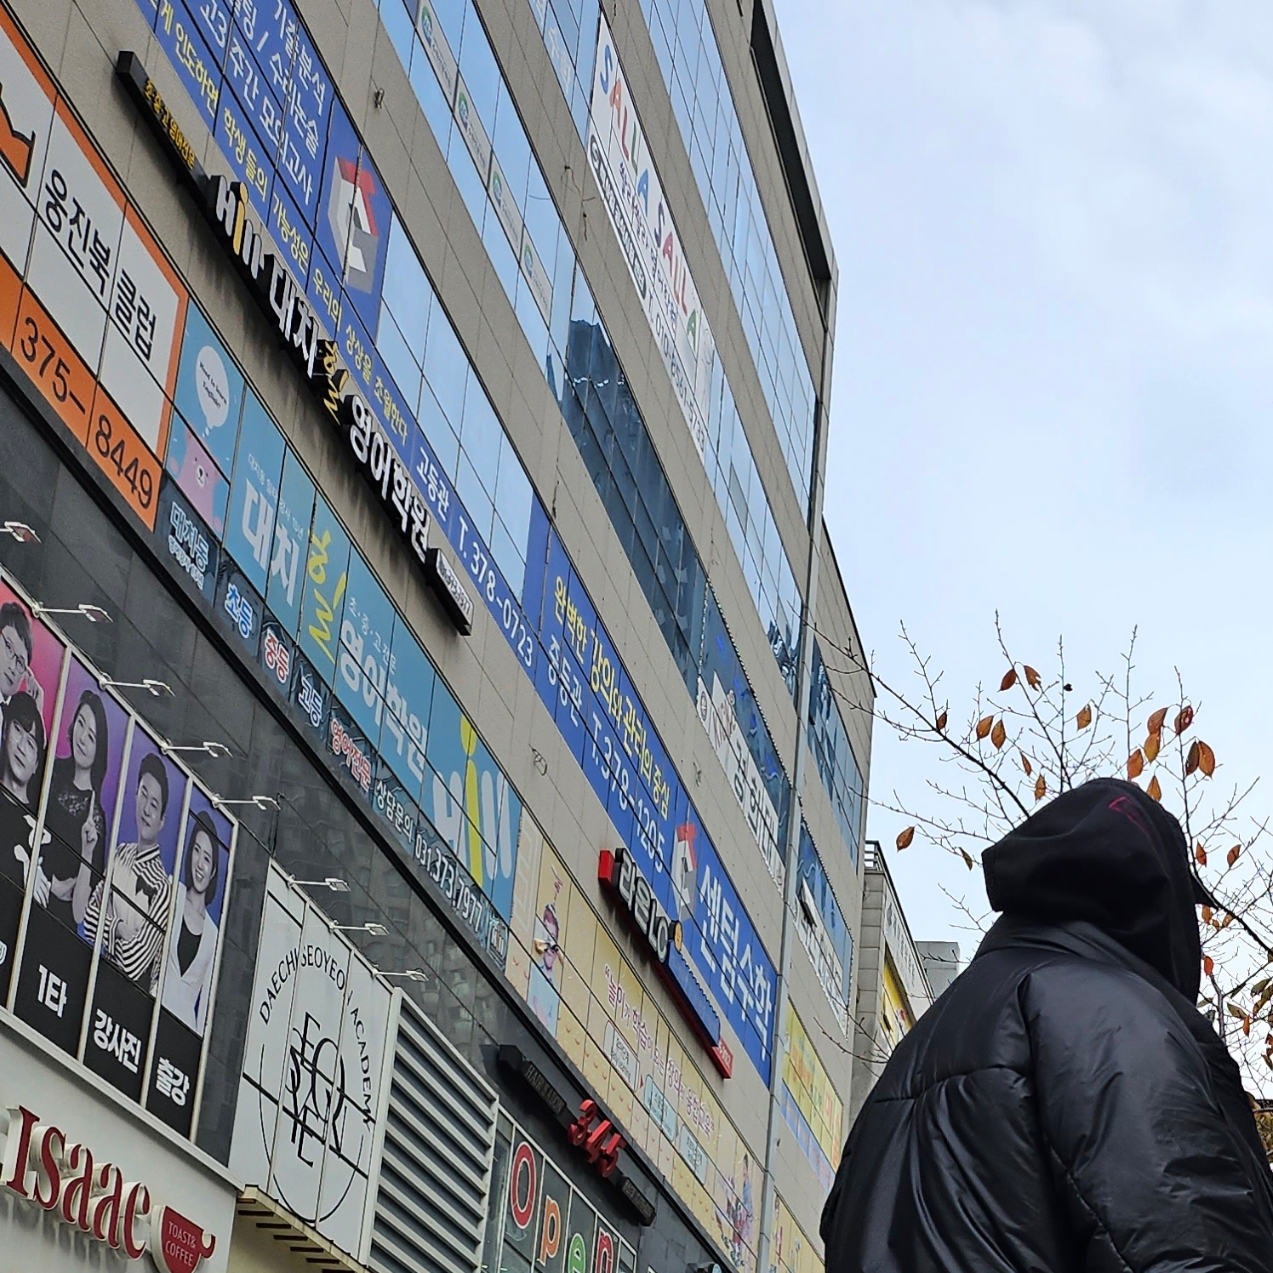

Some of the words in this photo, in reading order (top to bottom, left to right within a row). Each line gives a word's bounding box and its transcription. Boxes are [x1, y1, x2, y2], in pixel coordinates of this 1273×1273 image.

[230, 37, 259, 111] 주간
[260, 96, 313, 206] 모의고사
[600, 44, 649, 217] SALLA
[653, 201, 697, 352] SALLA
[175, 24, 219, 119] 인도하면
[272, 192, 310, 276] 가능성은
[314, 269, 342, 332] 우리의
[346, 323, 373, 386] 상상을
[374, 376, 408, 445] 초월한다
[417, 447, 450, 520] 고등관
[351, 394, 431, 564] 영어학원
[170, 501, 210, 572] 대치동
[242, 480, 299, 606] 대치
[224, 581, 253, 639] 초등
[554, 575, 588, 666] 완벽한
[263, 625, 290, 687] 중등
[549, 634, 583, 727] 중등관
[298, 675, 324, 729] 고등
[340, 620, 427, 784] 영어학원
[330, 717, 373, 793] 영어전문
[374, 780, 415, 846] 상담문의
[37, 962, 69, 1019] 1타
[699, 864, 773, 1061] 센텀수학
[94, 1009, 141, 1076] 강사진
[156, 1056, 190, 1109] 출강
[349, 1004, 377, 1127] ACADEMY
[6, 1105, 150, 1260] Isaac
[165, 1238, 195, 1268] COFFEE
